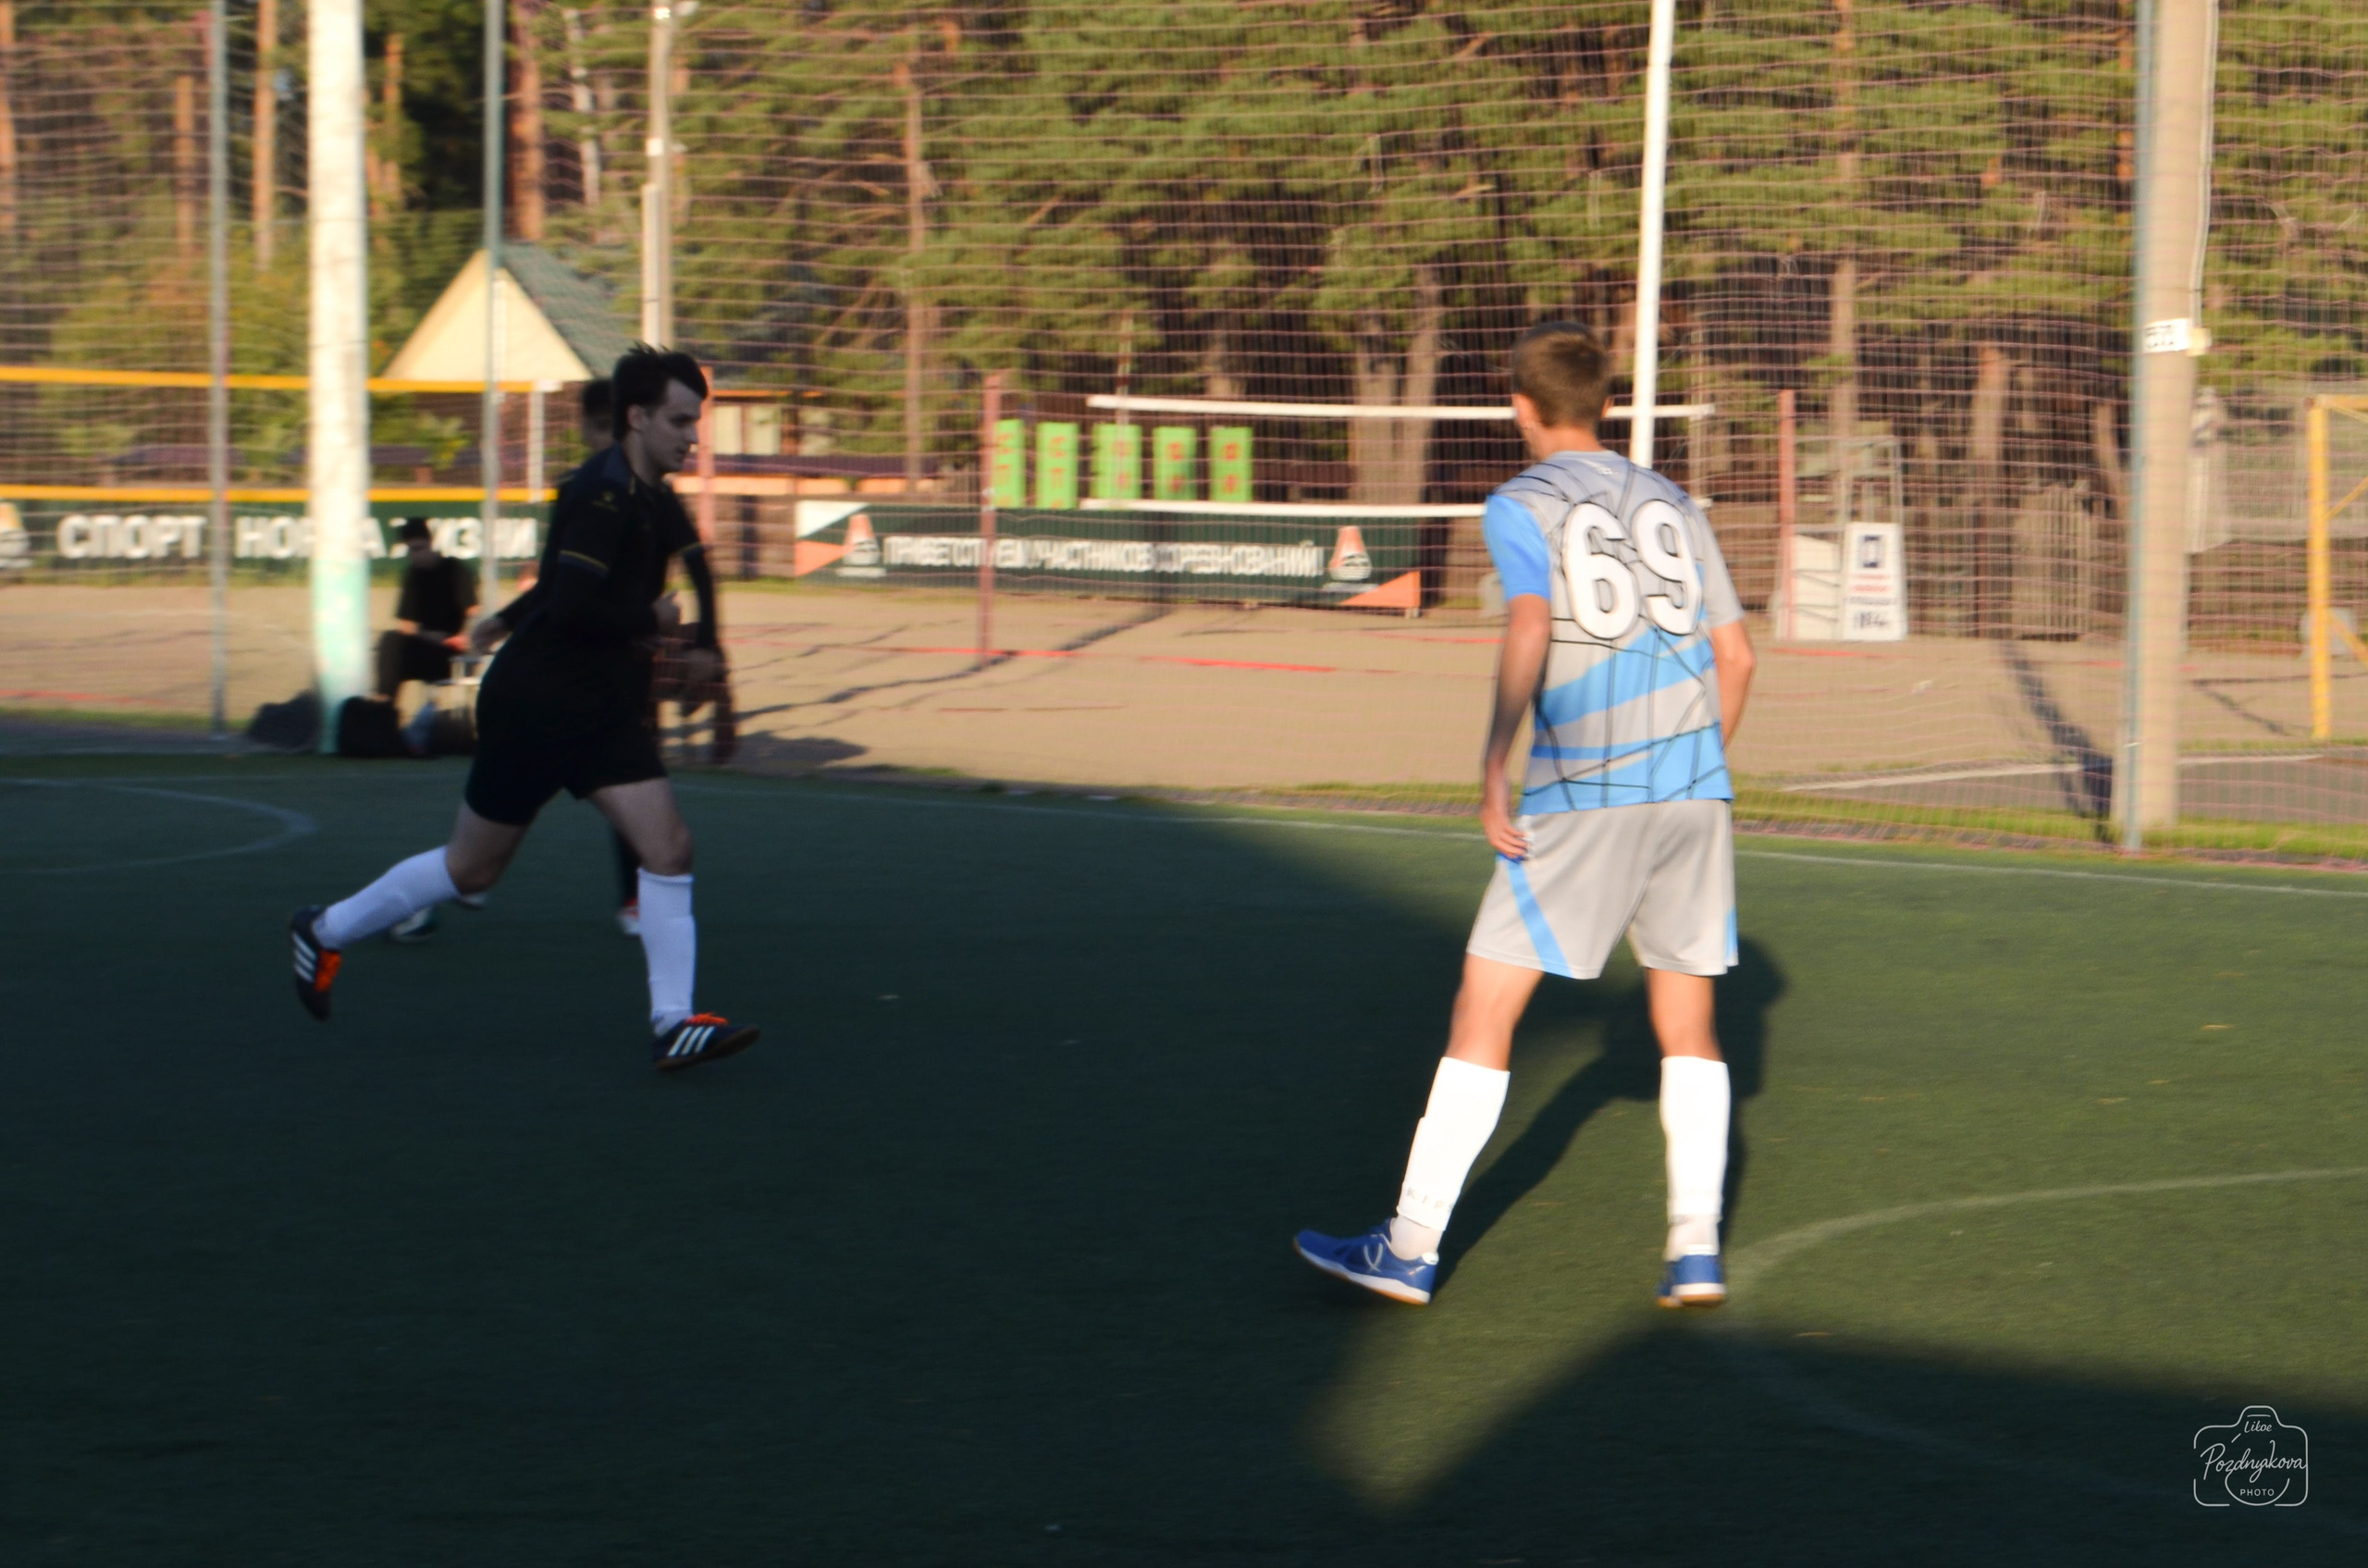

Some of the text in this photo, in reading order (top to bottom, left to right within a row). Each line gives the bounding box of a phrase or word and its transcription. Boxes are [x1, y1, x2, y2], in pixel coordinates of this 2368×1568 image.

[56, 514, 208, 559] СПОРТ
[235, 516, 388, 559] НОРА
[1561, 499, 1702, 640] 69
